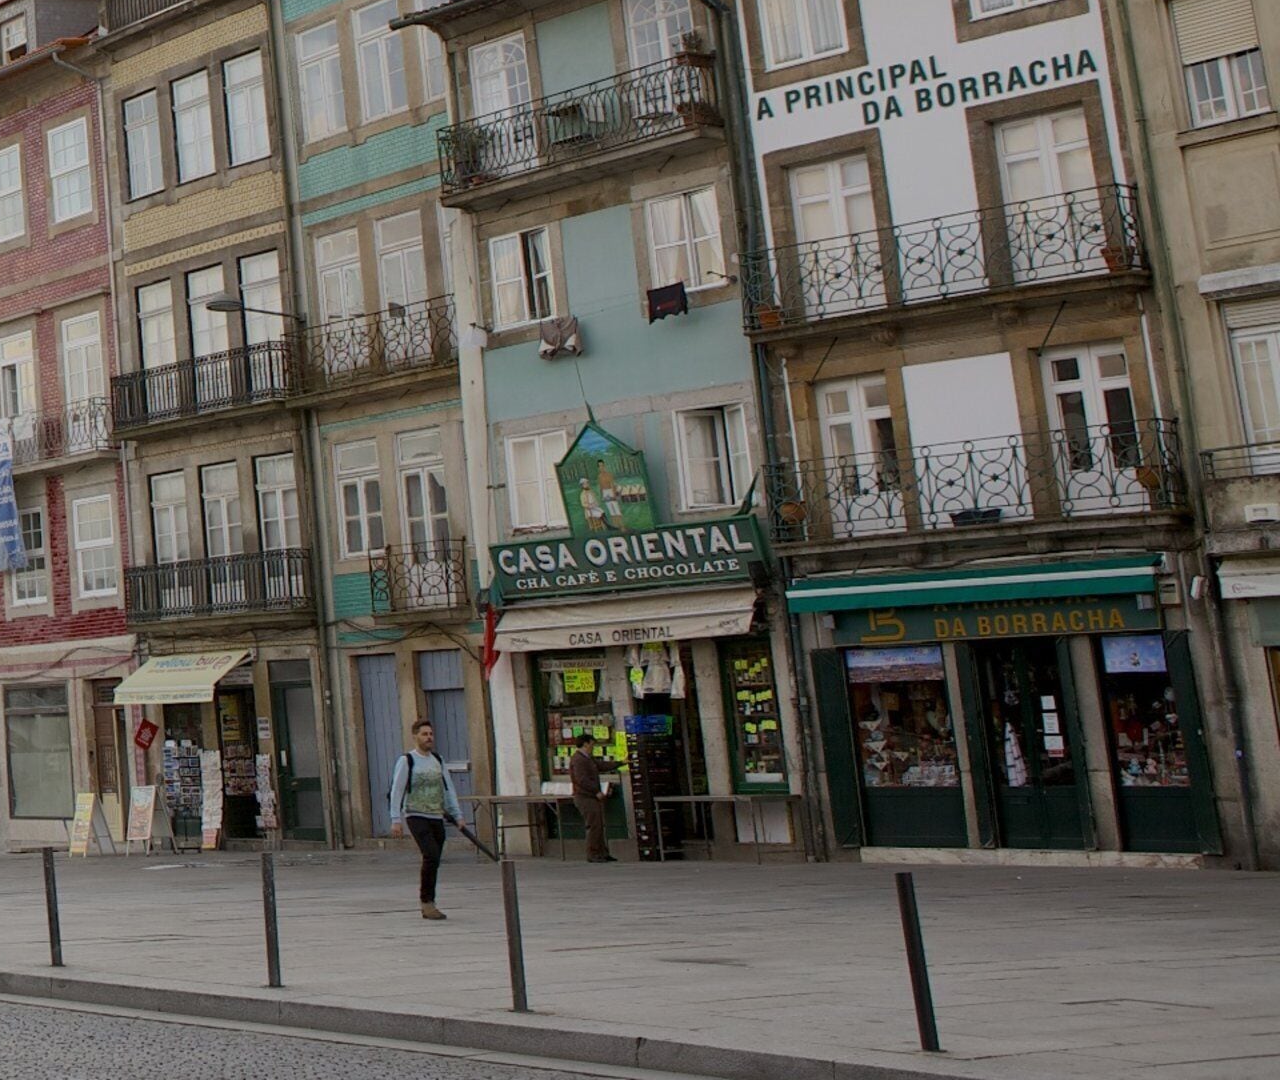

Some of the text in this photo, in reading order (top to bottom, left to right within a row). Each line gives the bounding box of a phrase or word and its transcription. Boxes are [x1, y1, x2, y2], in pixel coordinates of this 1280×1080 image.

[757, 55, 947, 120] A PRINCIPAL
[862, 49, 1097, 125] DA BORRACHA
[498, 524, 754, 575] CASA ORIENTAL
[606, 570, 617, 582] E
[624, 558, 740, 580] CHOCOLATE
[569, 626, 674, 646] CASA ORIENTAL
[934, 608, 1126, 638] DA BORRACHA
